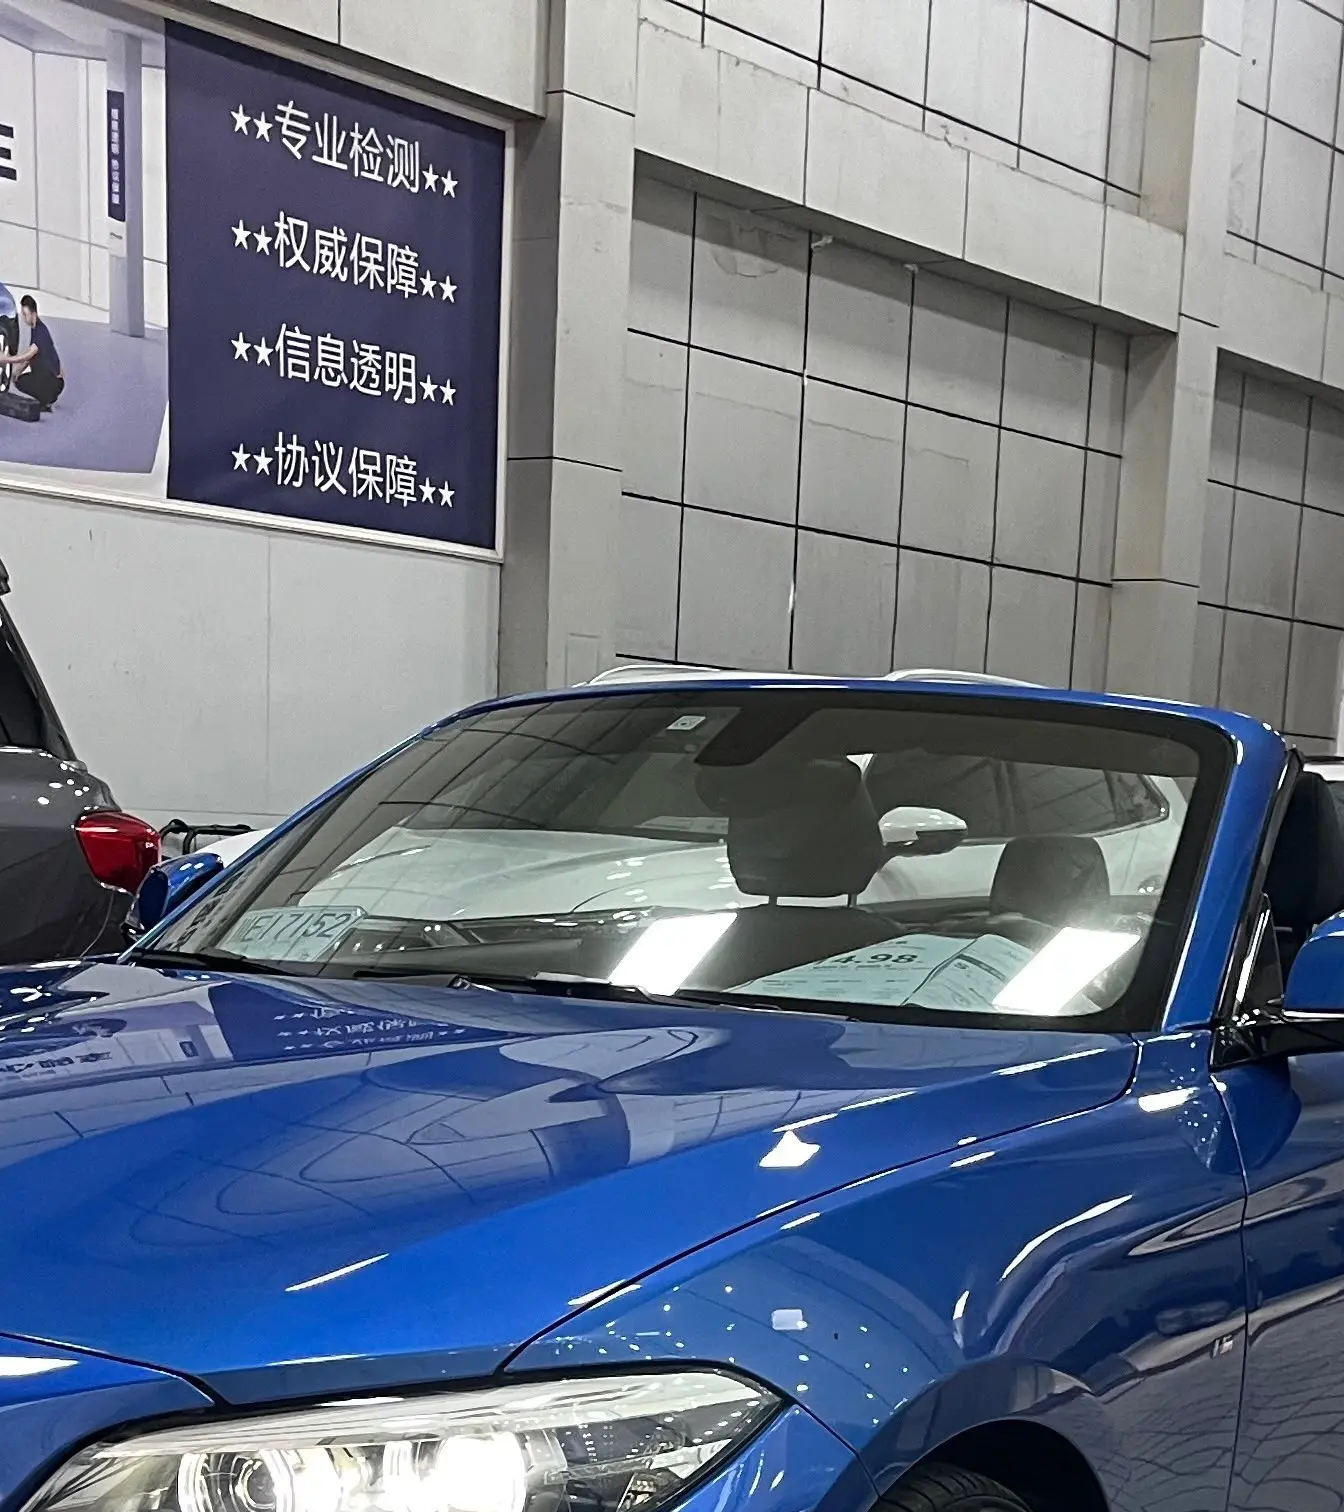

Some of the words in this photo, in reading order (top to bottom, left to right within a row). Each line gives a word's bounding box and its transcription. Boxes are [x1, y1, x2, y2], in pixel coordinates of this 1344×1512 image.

[275, 101, 419, 193] 专业检测
[274, 211, 418, 298] 权威保障
[275, 324, 415, 403] 信息透明
[275, 432, 417, 506] 协议保障
